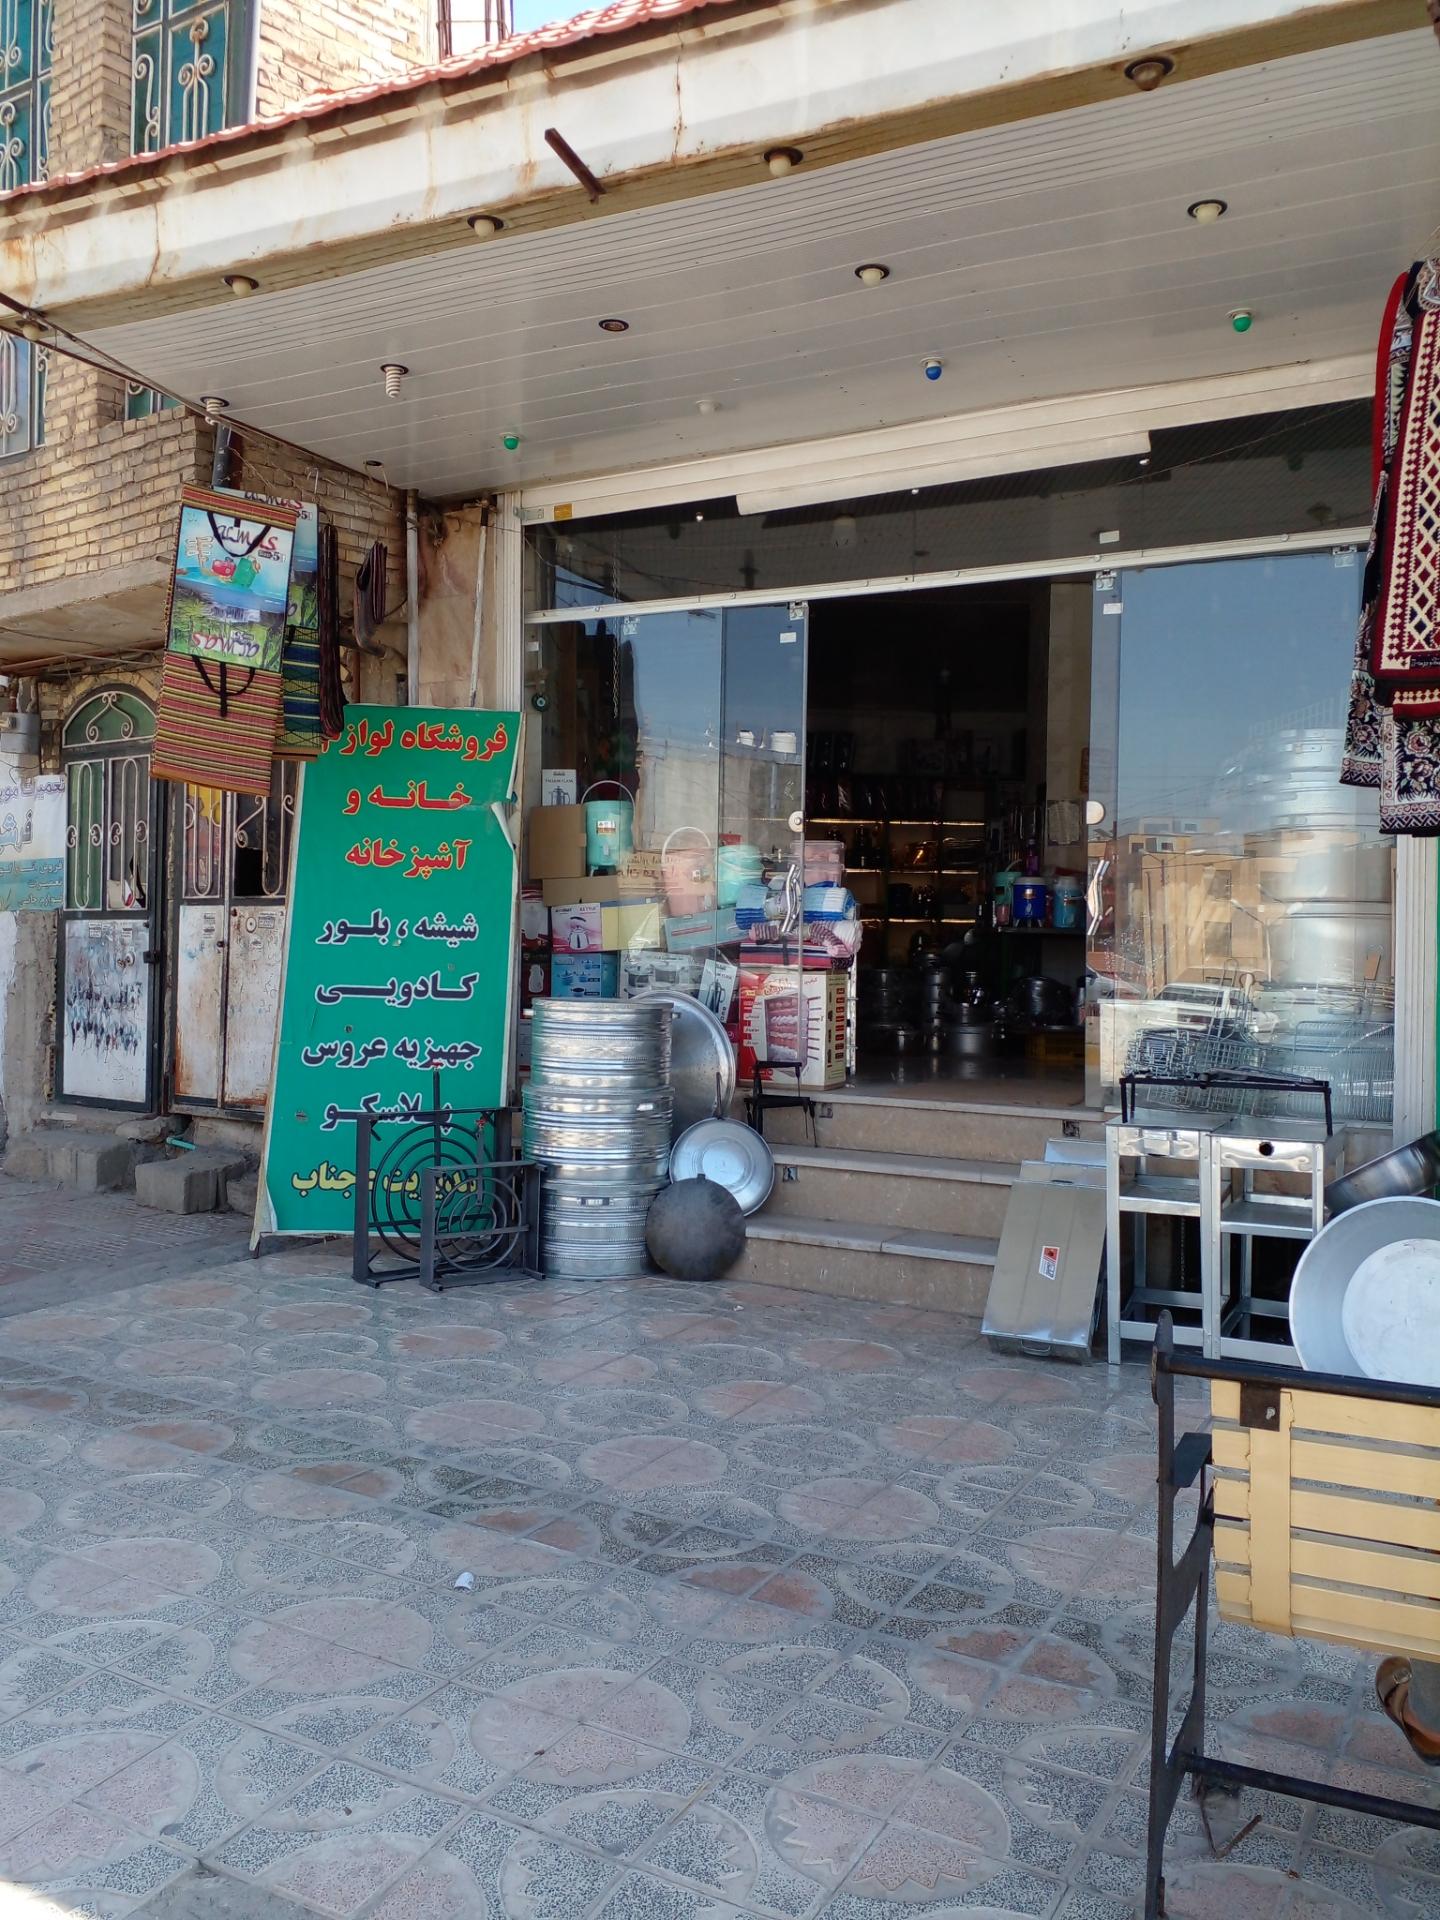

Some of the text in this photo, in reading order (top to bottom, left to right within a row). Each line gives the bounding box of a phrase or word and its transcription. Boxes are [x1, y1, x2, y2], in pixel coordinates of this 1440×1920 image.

[401, 720, 509, 762] فروشگاه
[342, 780, 473, 815] خانه و
[315, 908, 391, 946] بلور
[413, 912, 480, 948] شیشه
[315, 970, 481, 1008] کادویی
[301, 1035, 483, 1071] جهیزیه عروس
[291, 1160, 358, 1200] جناب
